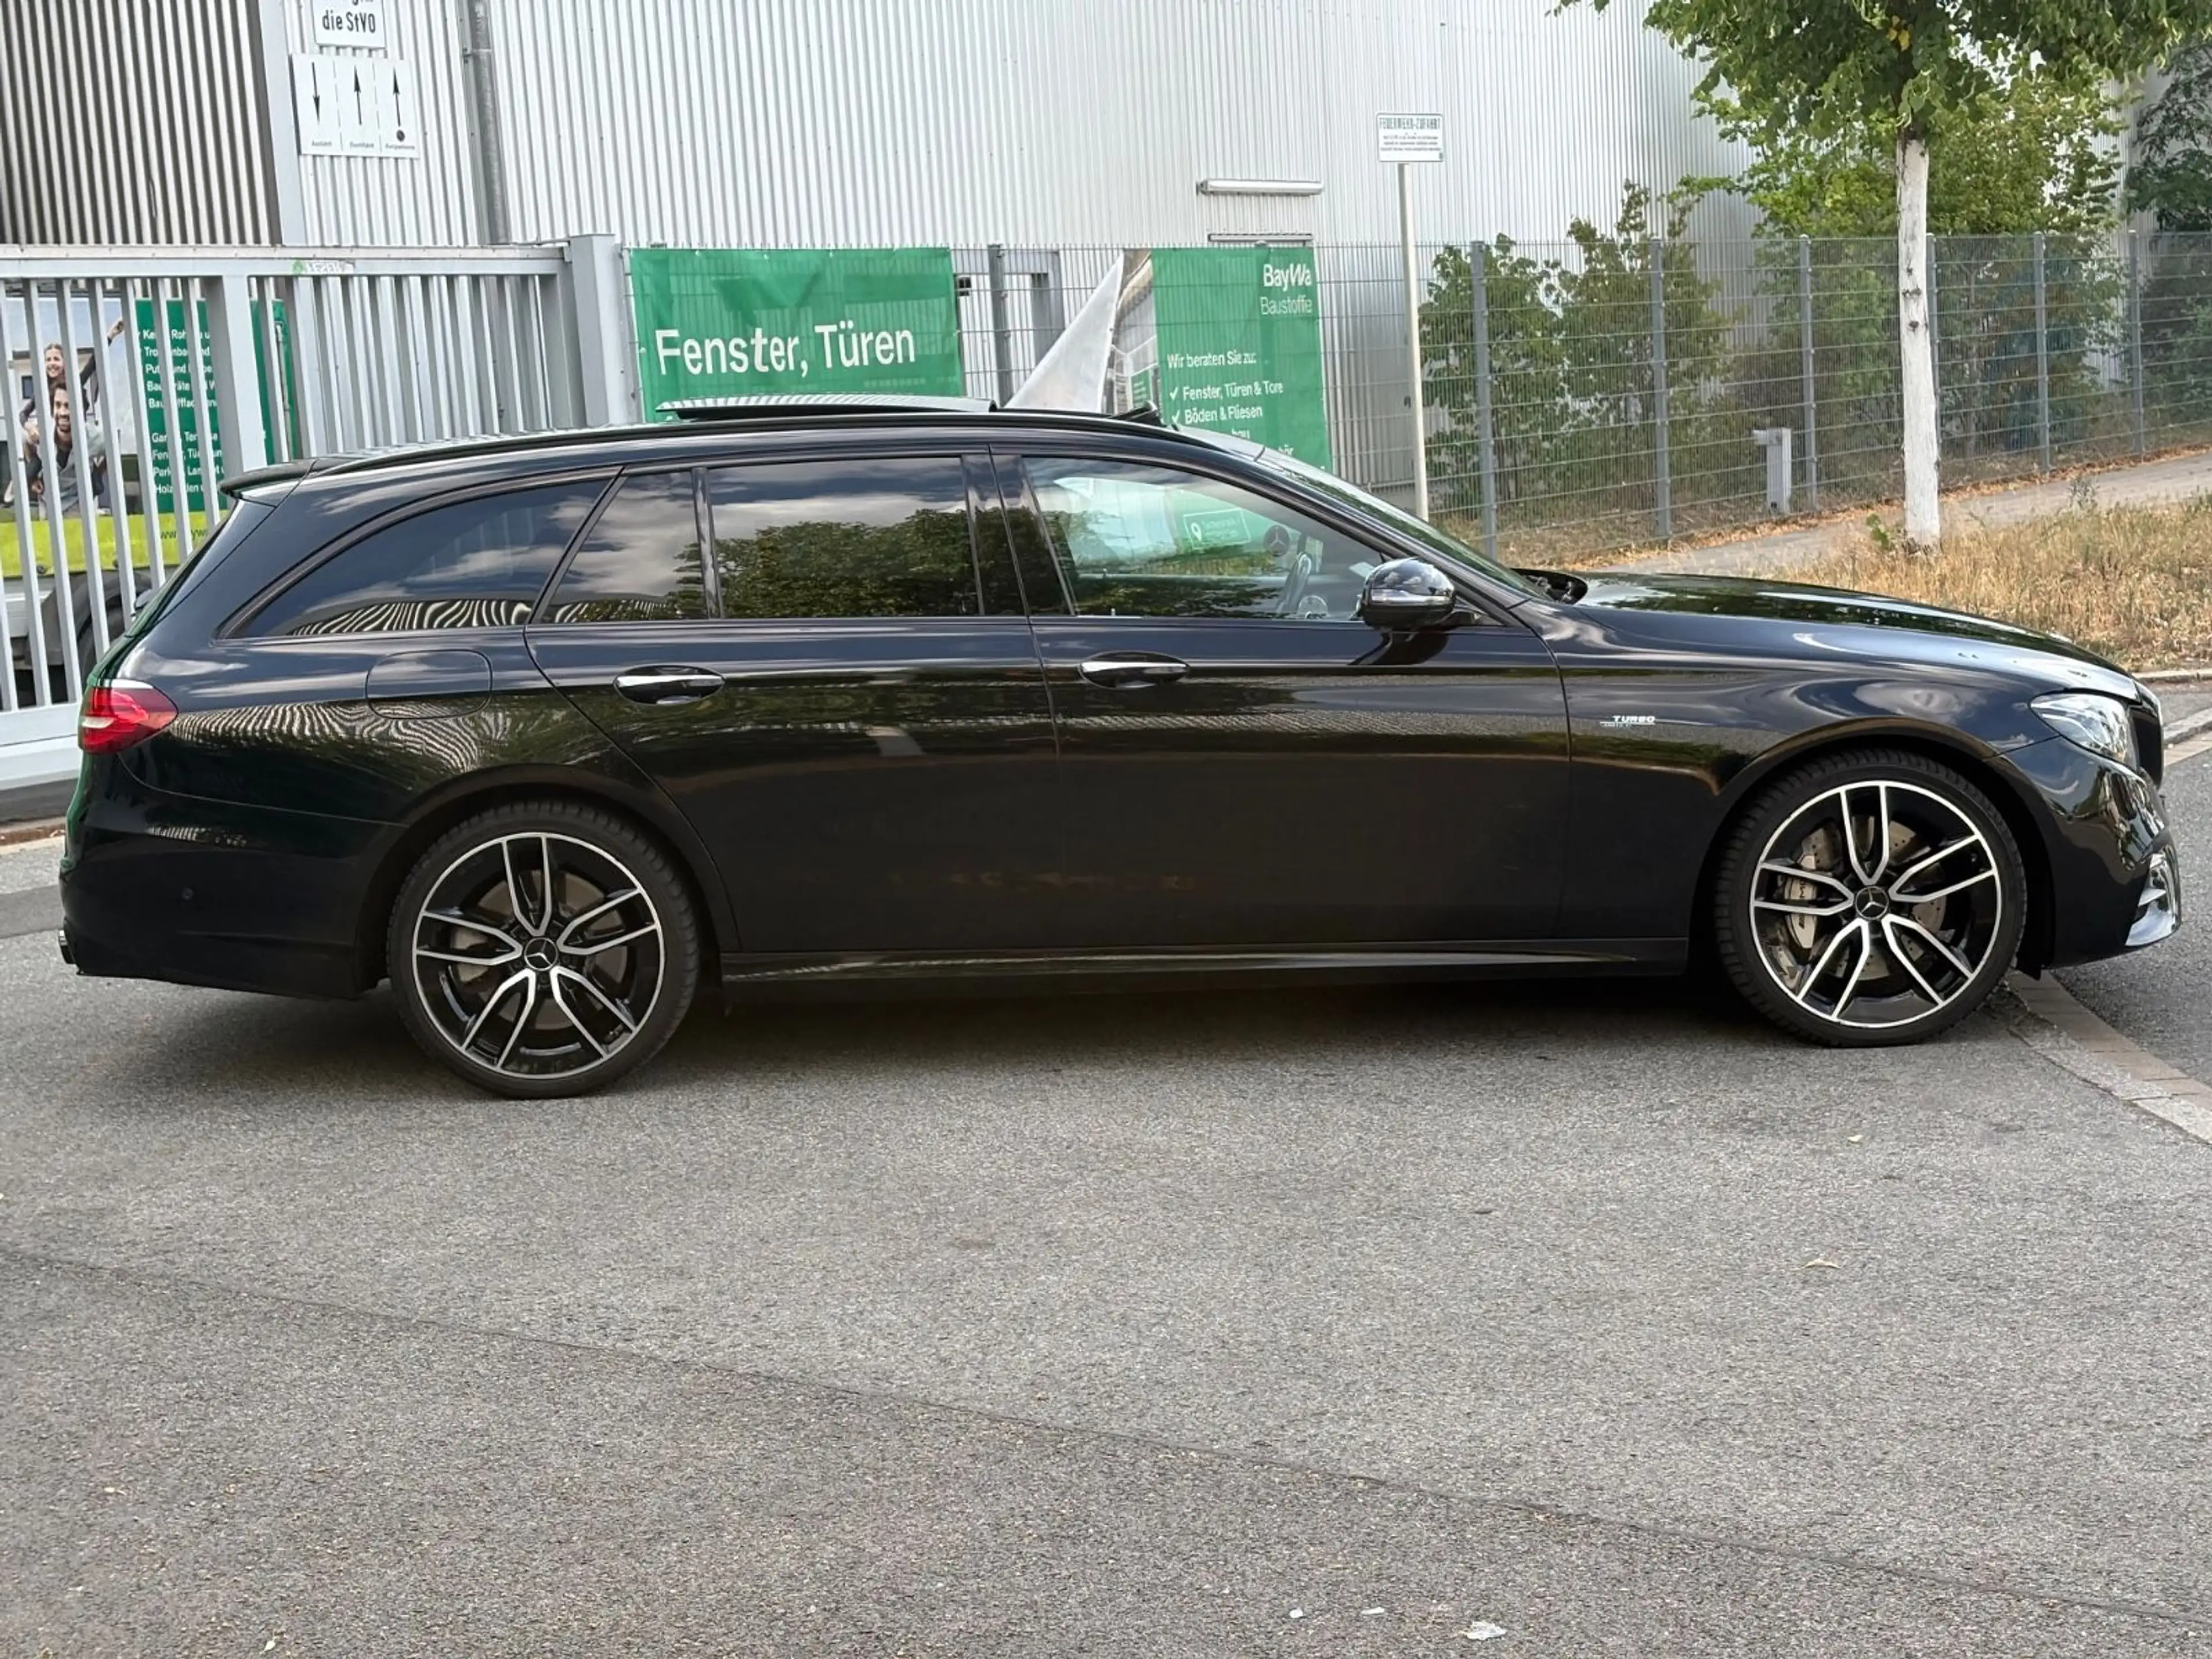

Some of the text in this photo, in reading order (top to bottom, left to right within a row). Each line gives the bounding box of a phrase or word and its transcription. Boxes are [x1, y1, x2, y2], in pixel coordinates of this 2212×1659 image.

[322, 9, 376, 33] die StVO
[1263, 263, 1312, 291] BayWa
[1260, 295, 1312, 315] Baustoffe
[655, 320, 916, 378] Fenster, Türen
[1167, 354, 1184, 368] Wir
[1186, 352, 1225, 368] beraten
[1227, 350, 1242, 365] Sie
[1183, 380, 1283, 400] Fenster, Türen & Tore
[1184, 404, 1263, 425] Böden & Fliesen
